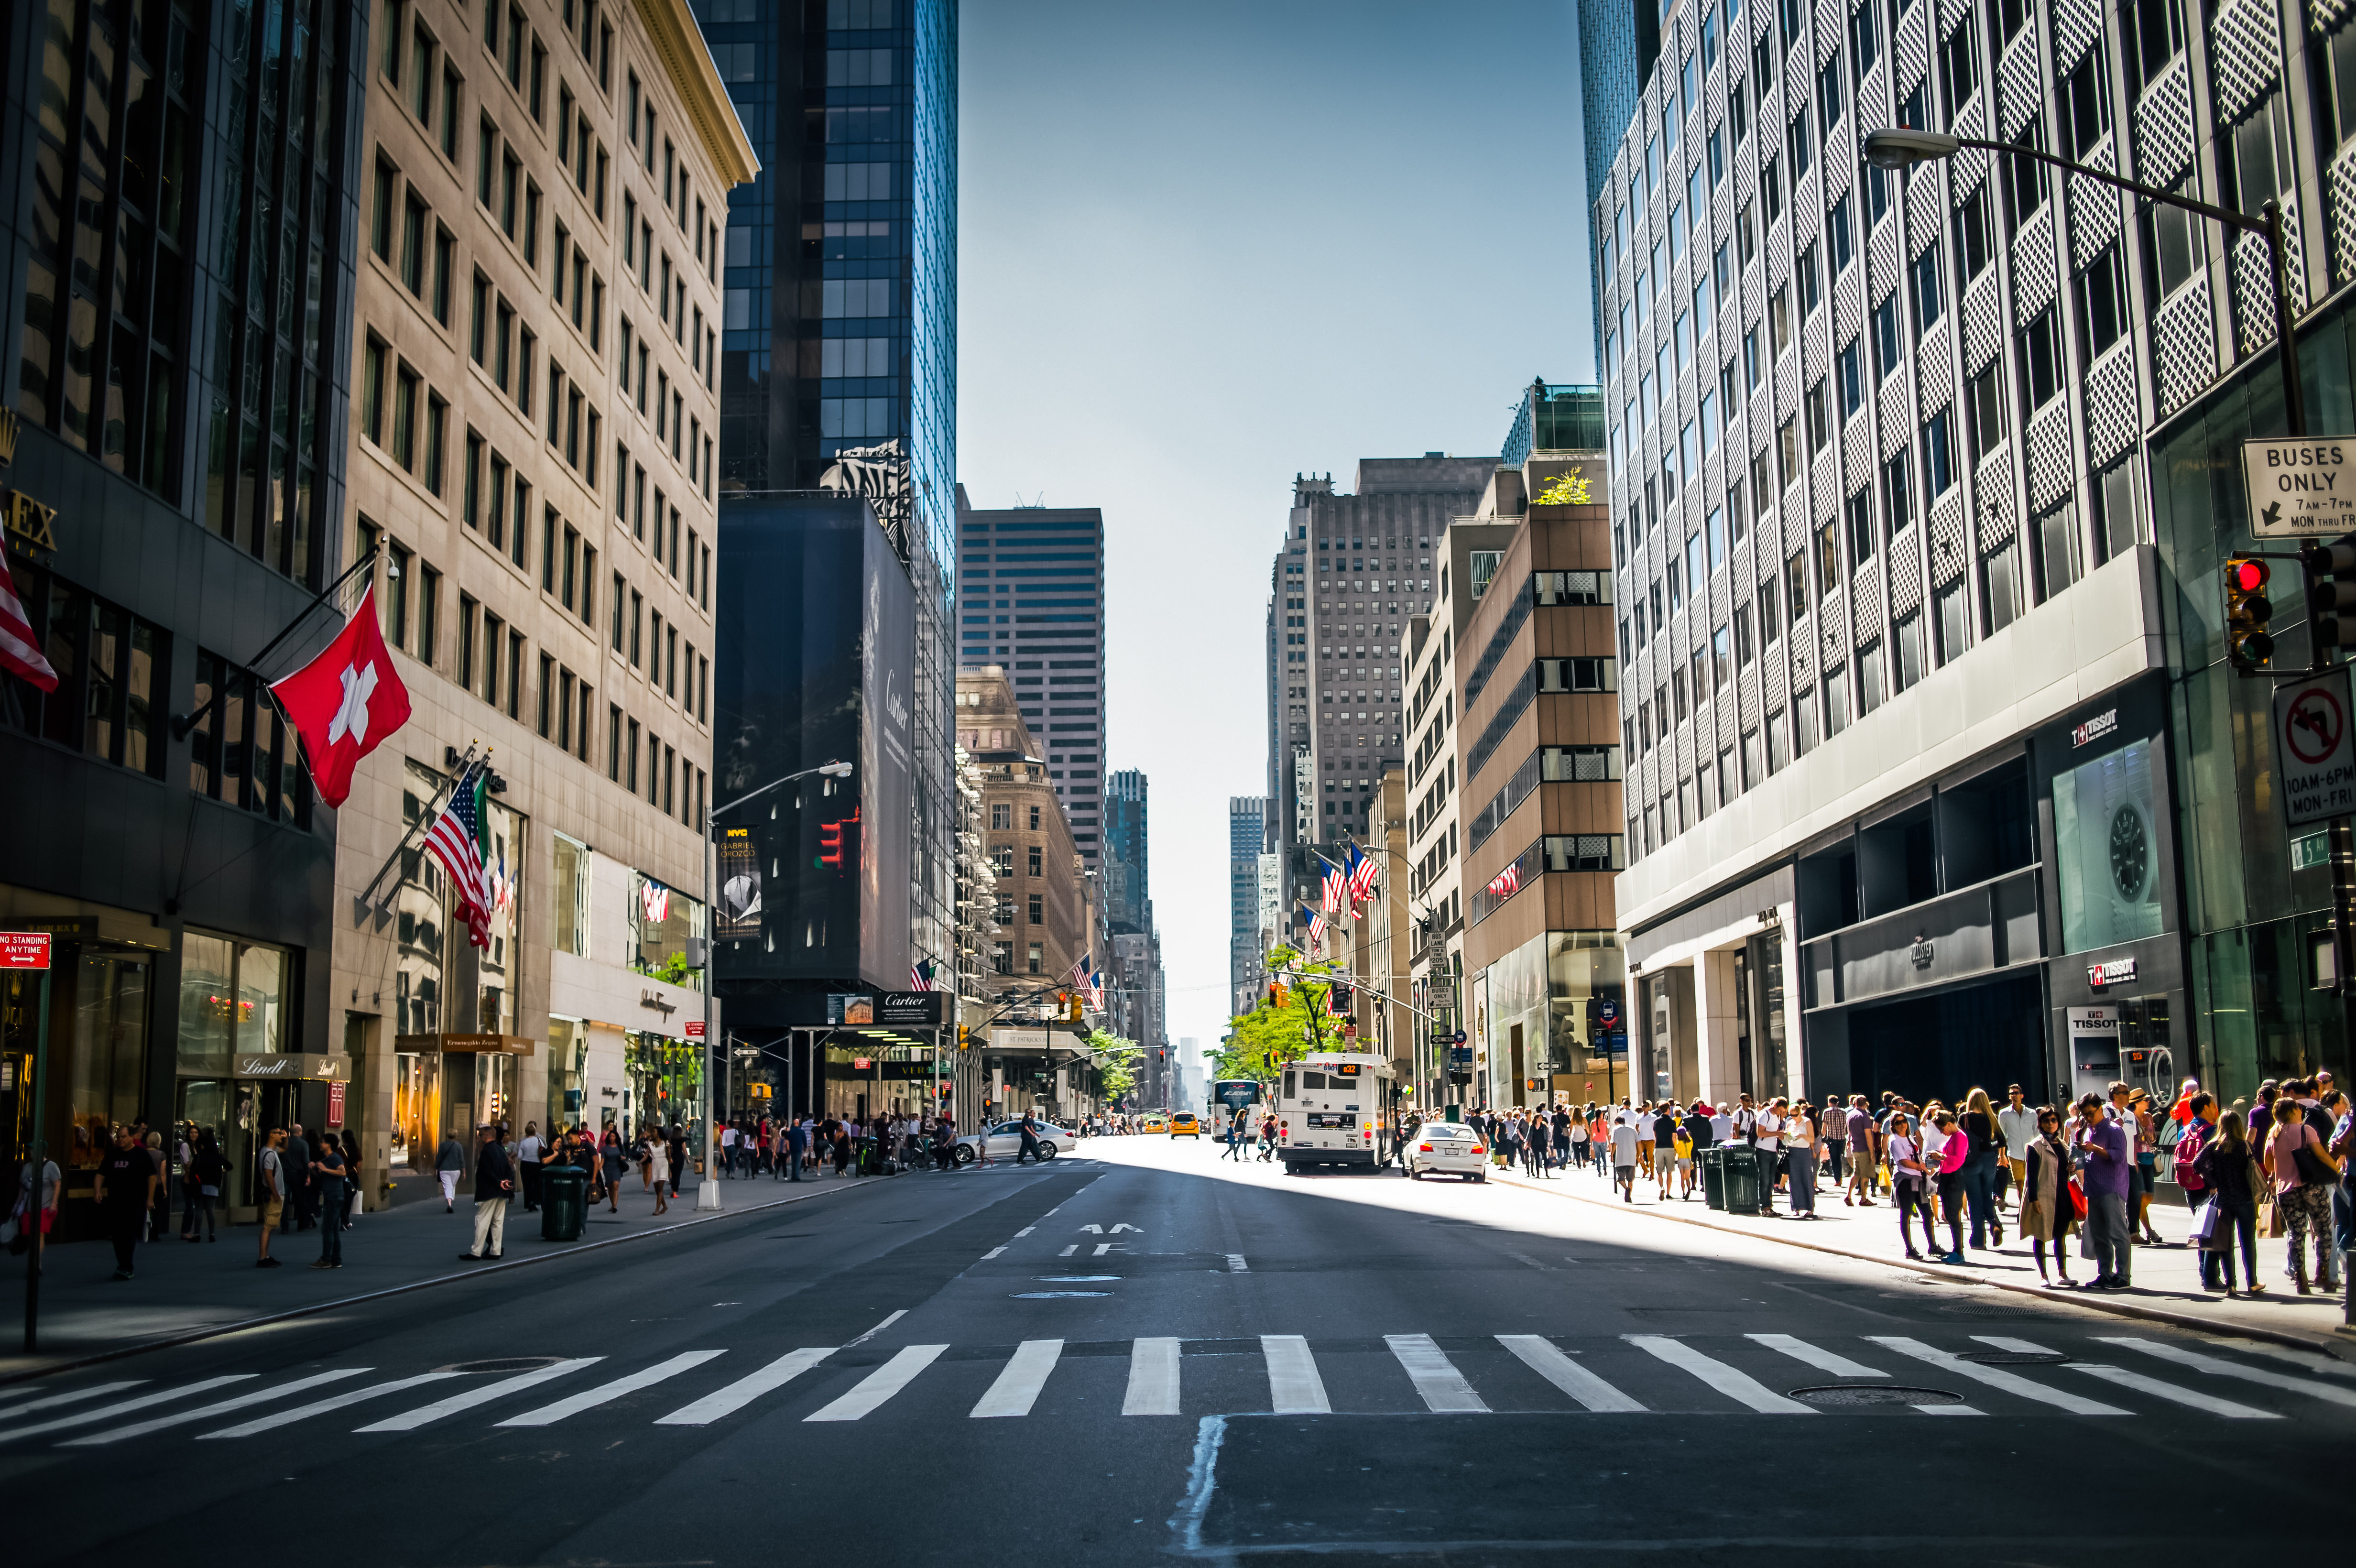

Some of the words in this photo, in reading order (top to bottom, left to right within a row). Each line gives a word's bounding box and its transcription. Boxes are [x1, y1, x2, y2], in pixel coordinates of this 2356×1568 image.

[2267, 446, 2344, 468] BUSES
[2279, 472, 2337, 492] ONLY
[2291, 516, 2314, 527] MON
[2318, 518, 2339, 526] THRU
[886, 669, 908, 732] Cartier
[2086, 708, 2116, 734] TISSOT
[2287, 765, 2354, 795] 10AM-6PM
[2293, 787, 2352, 815] MON-FRI
[727, 829, 748, 837] NYC
[720, 842, 754, 850] GABRIEL
[720, 849, 755, 858] OROZCO
[2306, 840, 2312, 863] 5
[12, 936, 47, 945] STANDING
[1909, 942, 1932, 961] HOLLISTER
[2103, 957, 2135, 977] TISSOT
[885, 994, 926, 1006] Cartier
[2073, 1019, 2117, 1028] TISSOT
[238, 1057, 287, 1075] Lindt
[317, 1058, 336, 1077] Lindt
